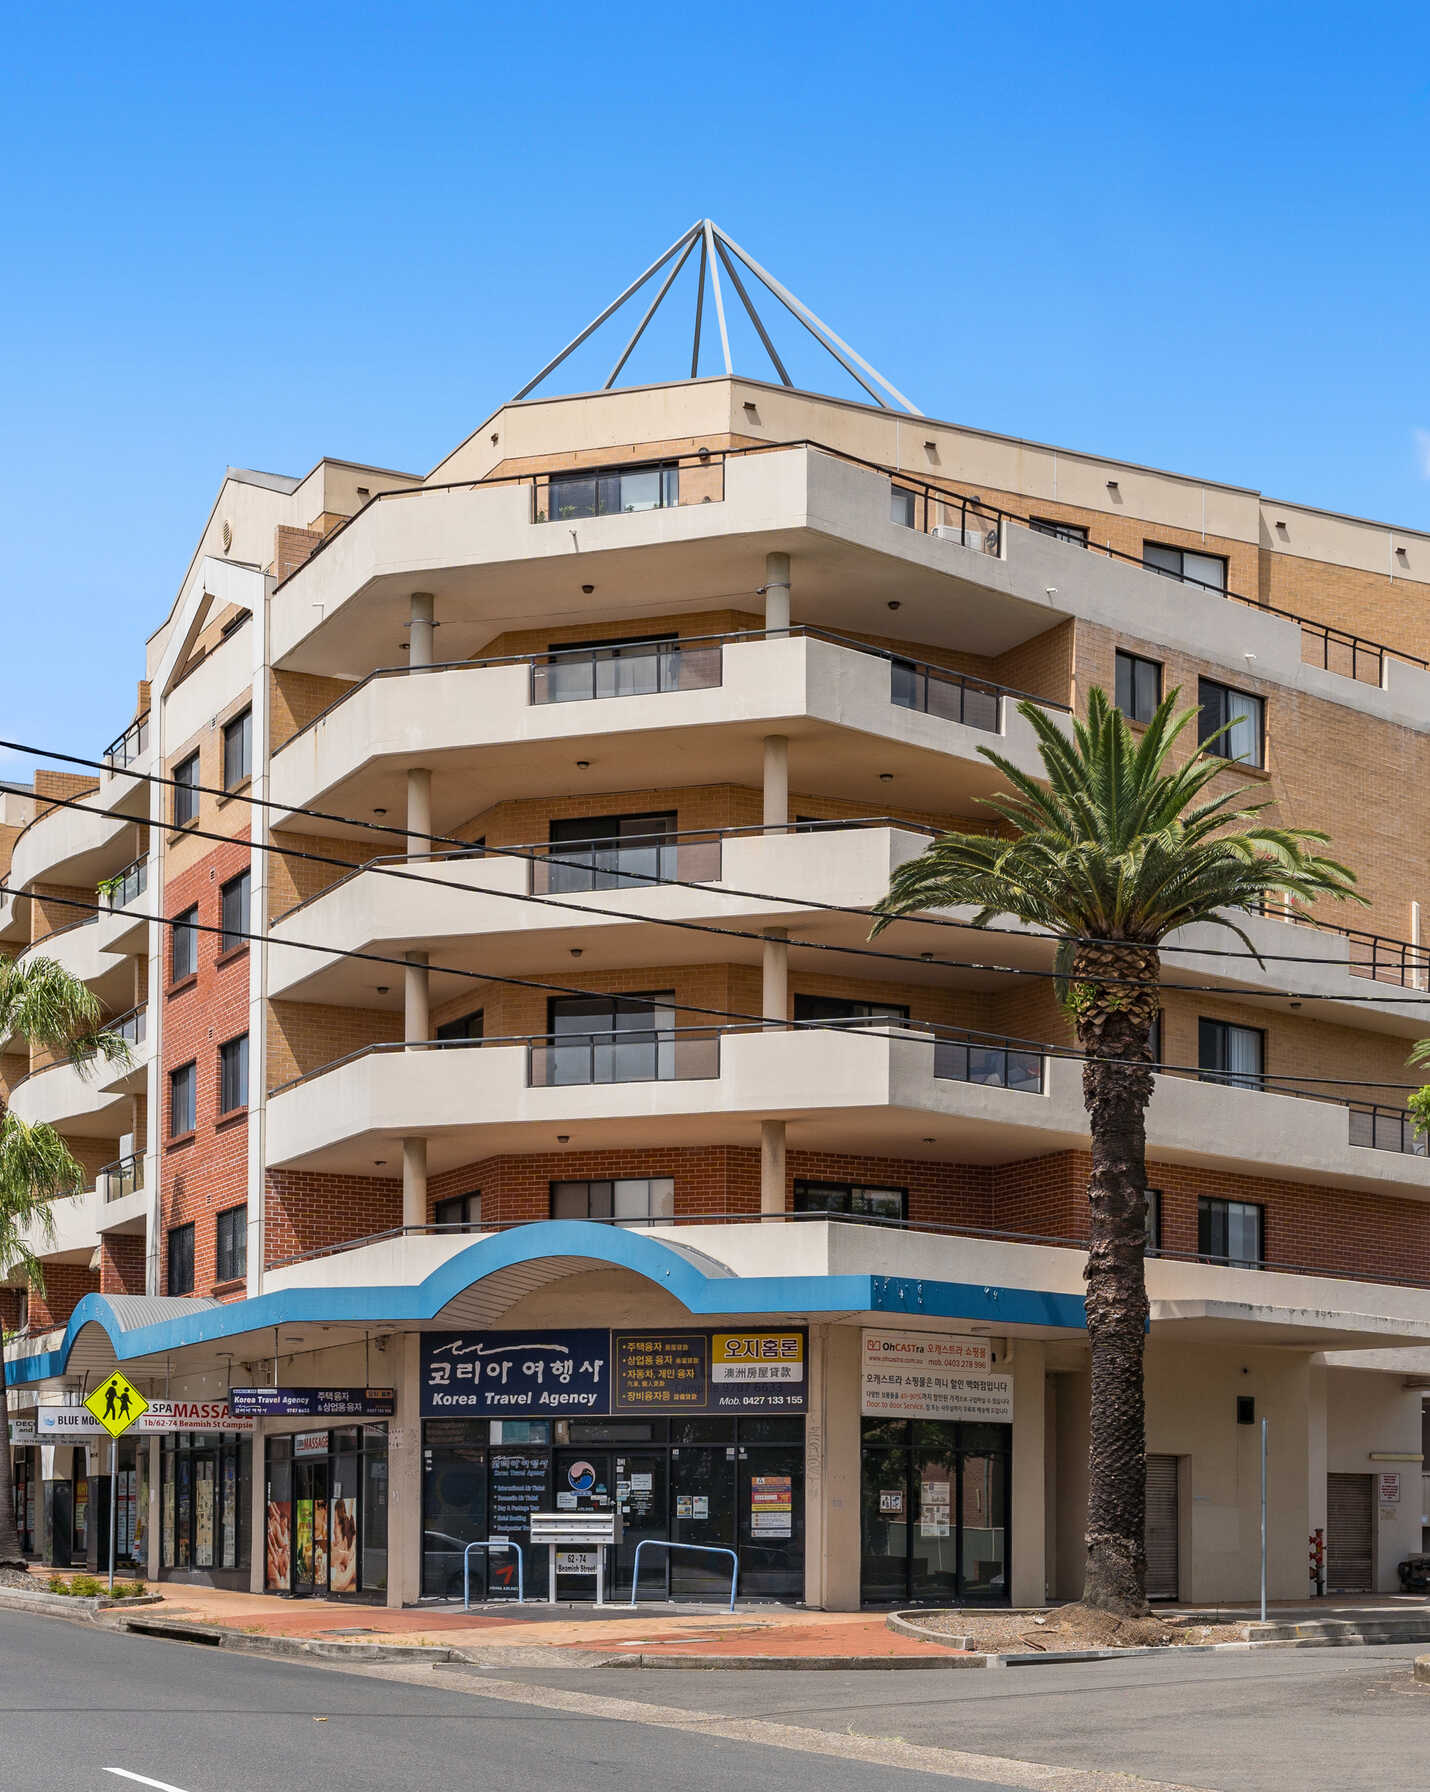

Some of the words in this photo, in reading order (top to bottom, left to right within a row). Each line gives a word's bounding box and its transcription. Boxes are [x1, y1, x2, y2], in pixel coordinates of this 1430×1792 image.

[724, 1338, 799, 1359] 오지홈론
[883, 1342, 925, 1354] OhCASTra
[429, 1360, 513, 1385] 코리아
[522, 1359, 604, 1384] 여행사
[724, 1366, 791, 1380] 澳洲房屋貸款
[866, 1374, 902, 1385] 오캐스트라
[935, 1378, 949, 1389] 미니
[235, 1396, 256, 1404] Korea
[258, 1395, 280, 1404] Travel
[282, 1396, 310, 1405] Agency
[433, 1393, 477, 1406] Korea
[485, 1392, 532, 1405] Travel
[539, 1391, 598, 1406] Agency
[720, 1397, 741, 1406] Mob.
[743, 1397, 767, 1405] 0427
[769, 1396, 784, 1405] 133
[787, 1396, 803, 1404] 155
[153, 1403, 172, 1413] SPA
[174, 1404, 253, 1419] MASSA
[58, 1416, 79, 1425] BLUE
[179, 1420, 212, 1428] Beamish
[222, 1421, 253, 1430] Campsie
[568, 1554, 575, 1563] 62
[580, 1554, 587, 1563] 74
[559, 1564, 579, 1573] Beamish
